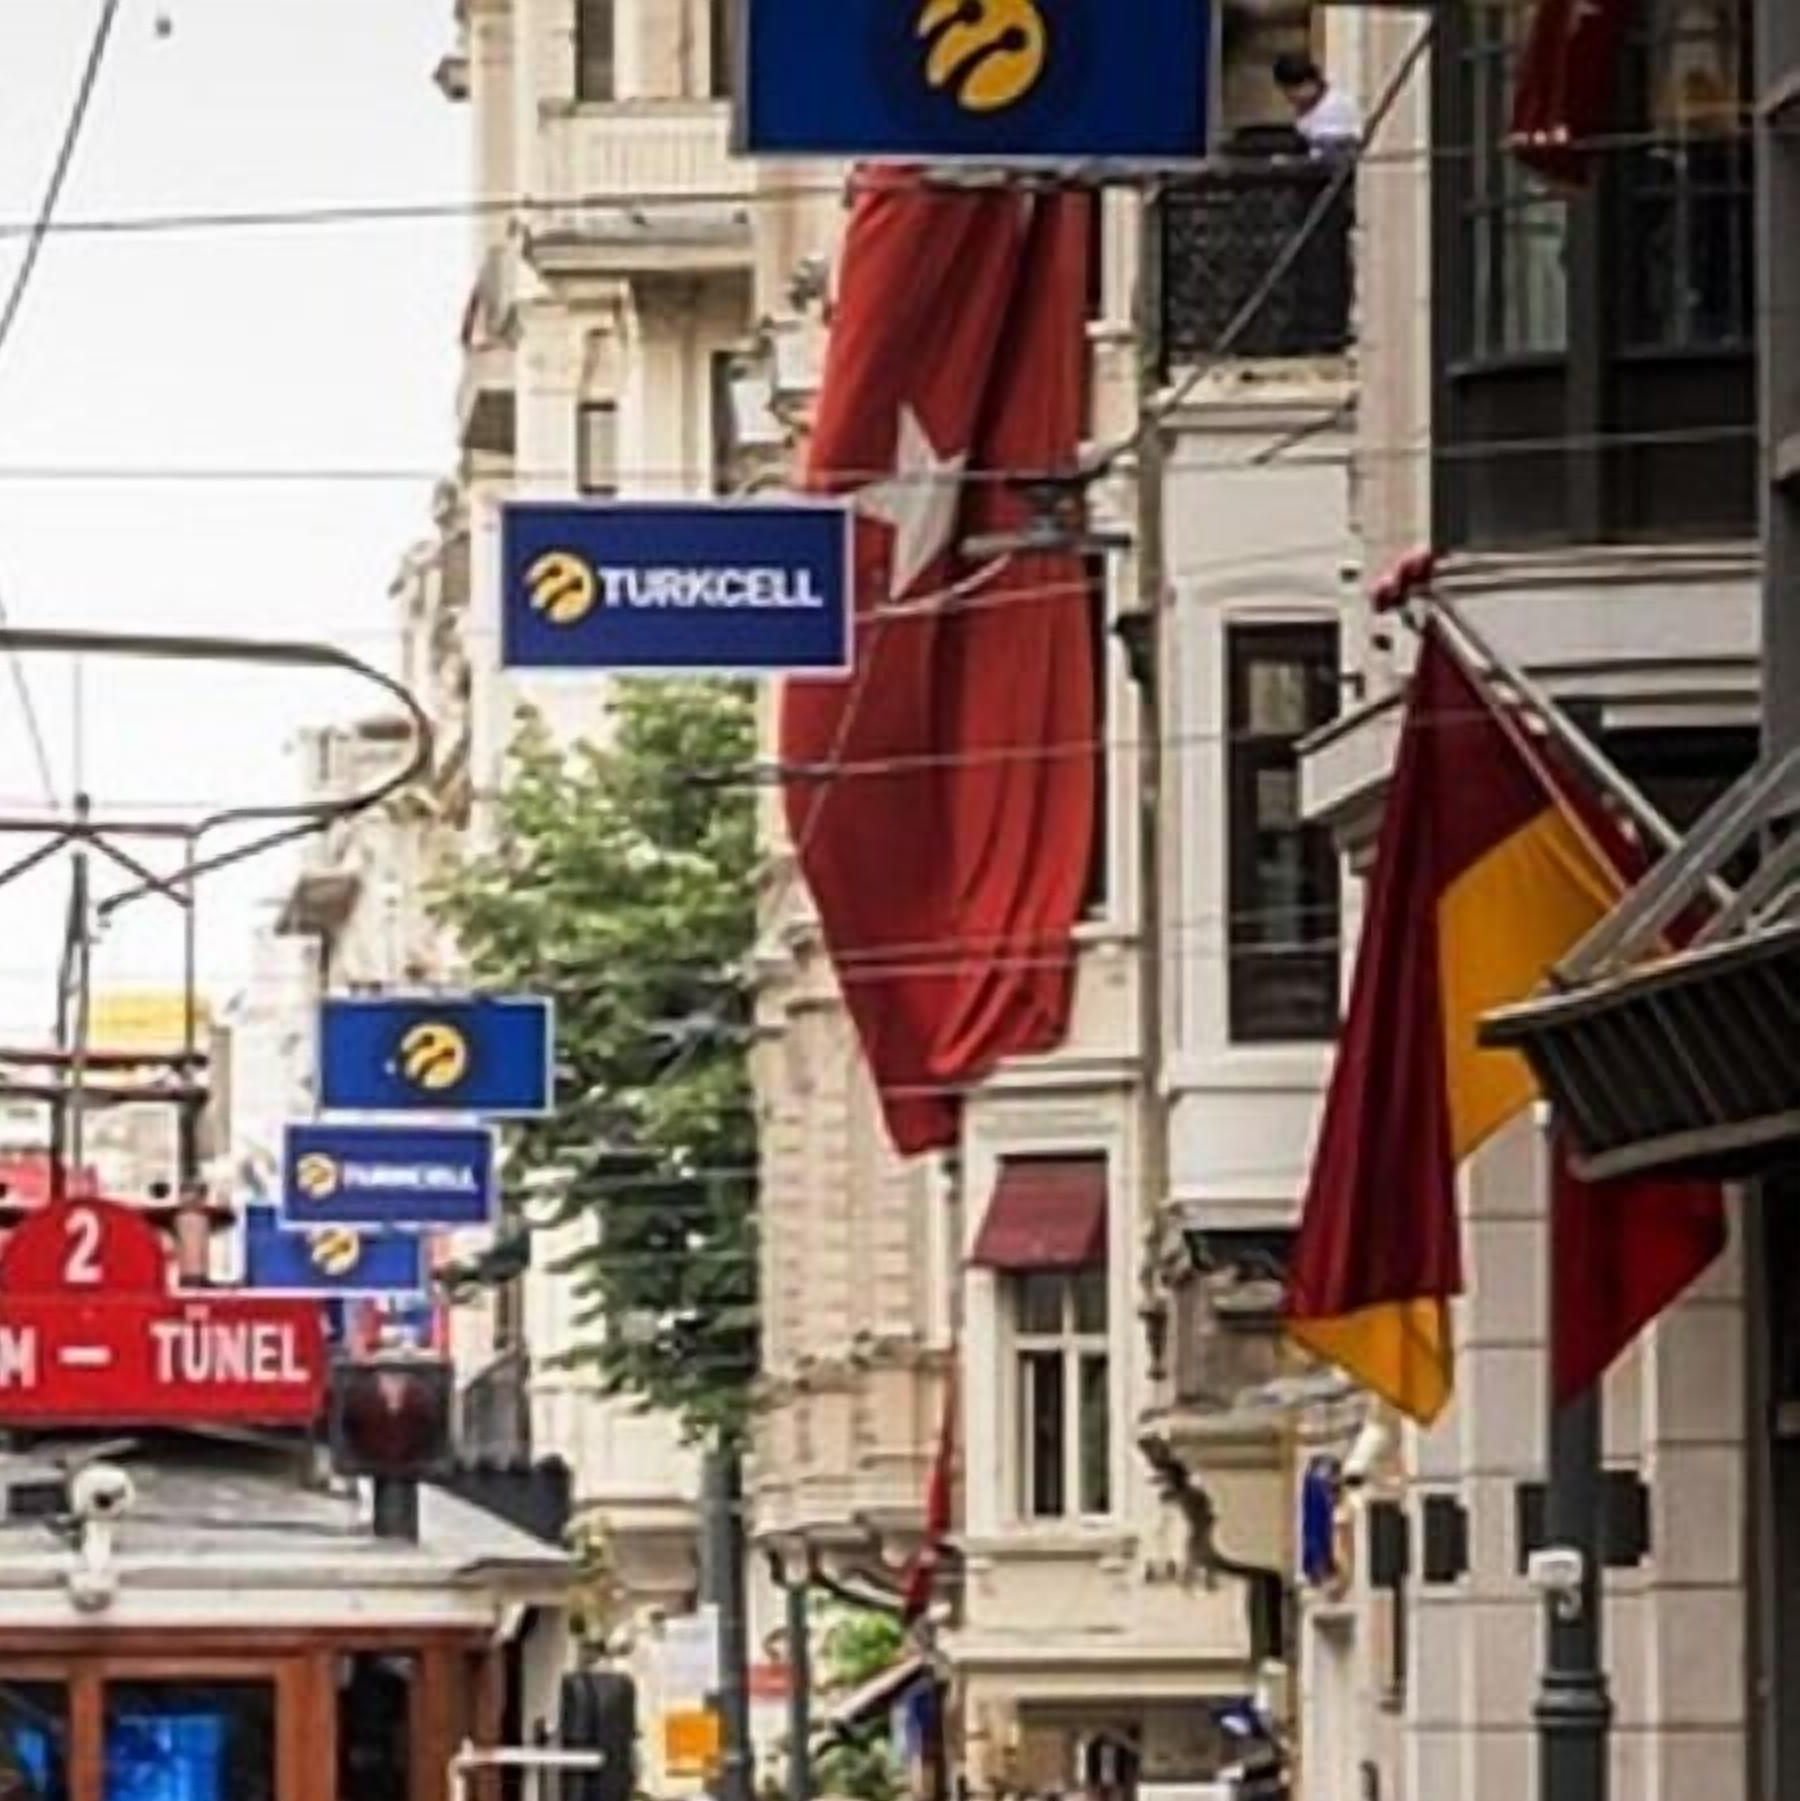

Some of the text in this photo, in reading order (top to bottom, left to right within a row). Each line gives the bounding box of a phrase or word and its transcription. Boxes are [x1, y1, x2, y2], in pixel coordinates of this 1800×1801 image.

[598, 566, 823, 608] TURKCELL
[64, 1209, 104, 1284] 2
[151, 1304, 310, 1385] TÜNEL
